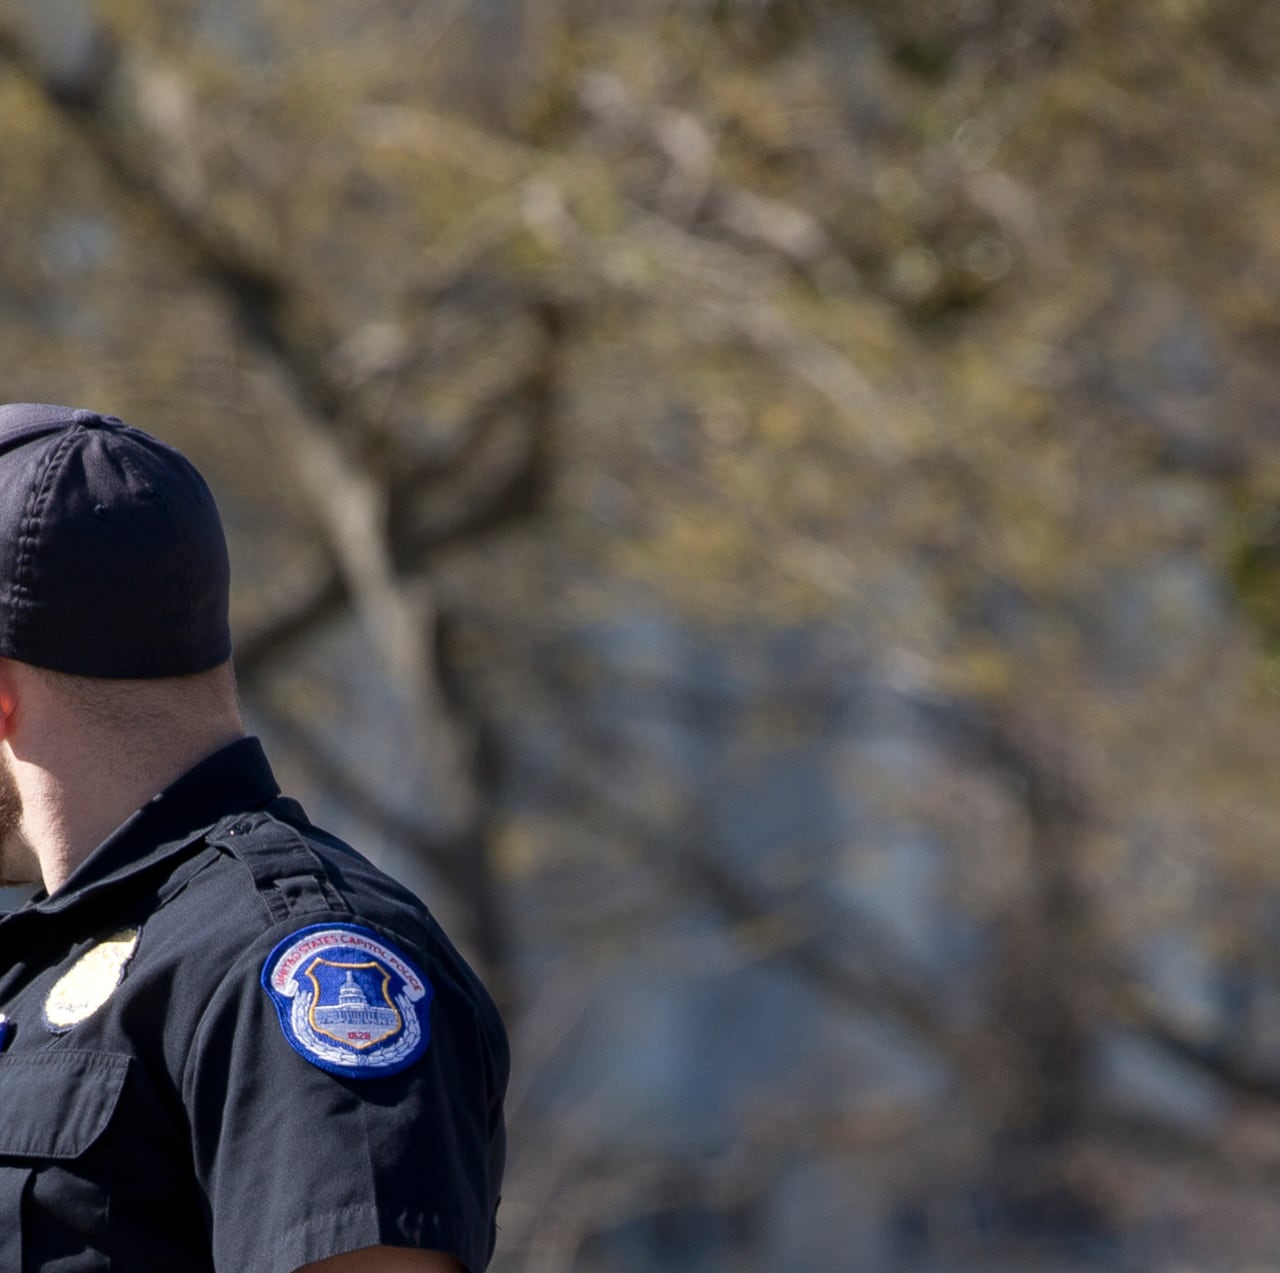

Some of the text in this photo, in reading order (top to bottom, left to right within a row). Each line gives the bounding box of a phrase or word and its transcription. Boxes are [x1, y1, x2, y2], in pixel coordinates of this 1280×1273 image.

[275, 934, 423, 992] UNITED STATES CAPITOL POLICE
[347, 1031, 371, 1040] 1828
